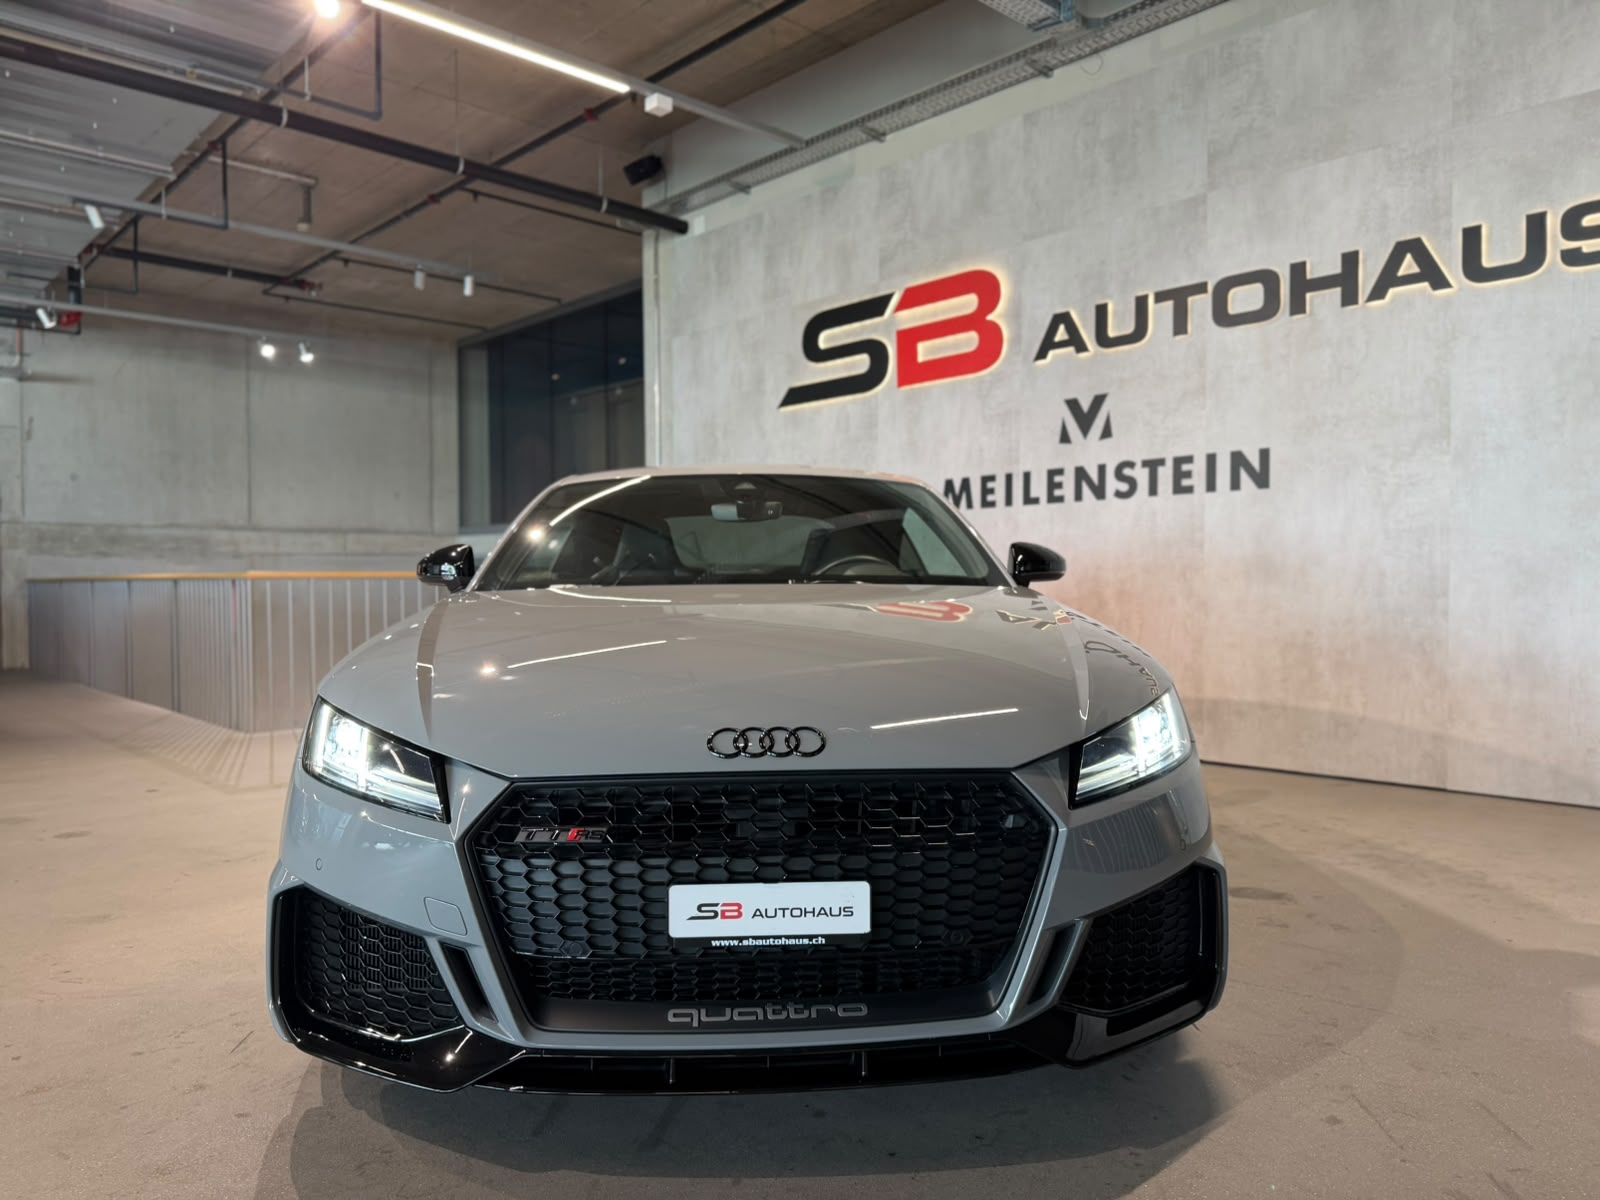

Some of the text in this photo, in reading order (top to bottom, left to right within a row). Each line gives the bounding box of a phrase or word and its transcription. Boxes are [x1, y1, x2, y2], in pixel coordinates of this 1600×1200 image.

[778, 269, 1004, 409] SB
[944, 447, 1270, 510] MEILENSTEIN
[686, 902, 854, 920] SB AUTOHAUS
[711, 936, 825, 947] www.sbautohaus.ch
[667, 1002, 868, 1027] quattro
